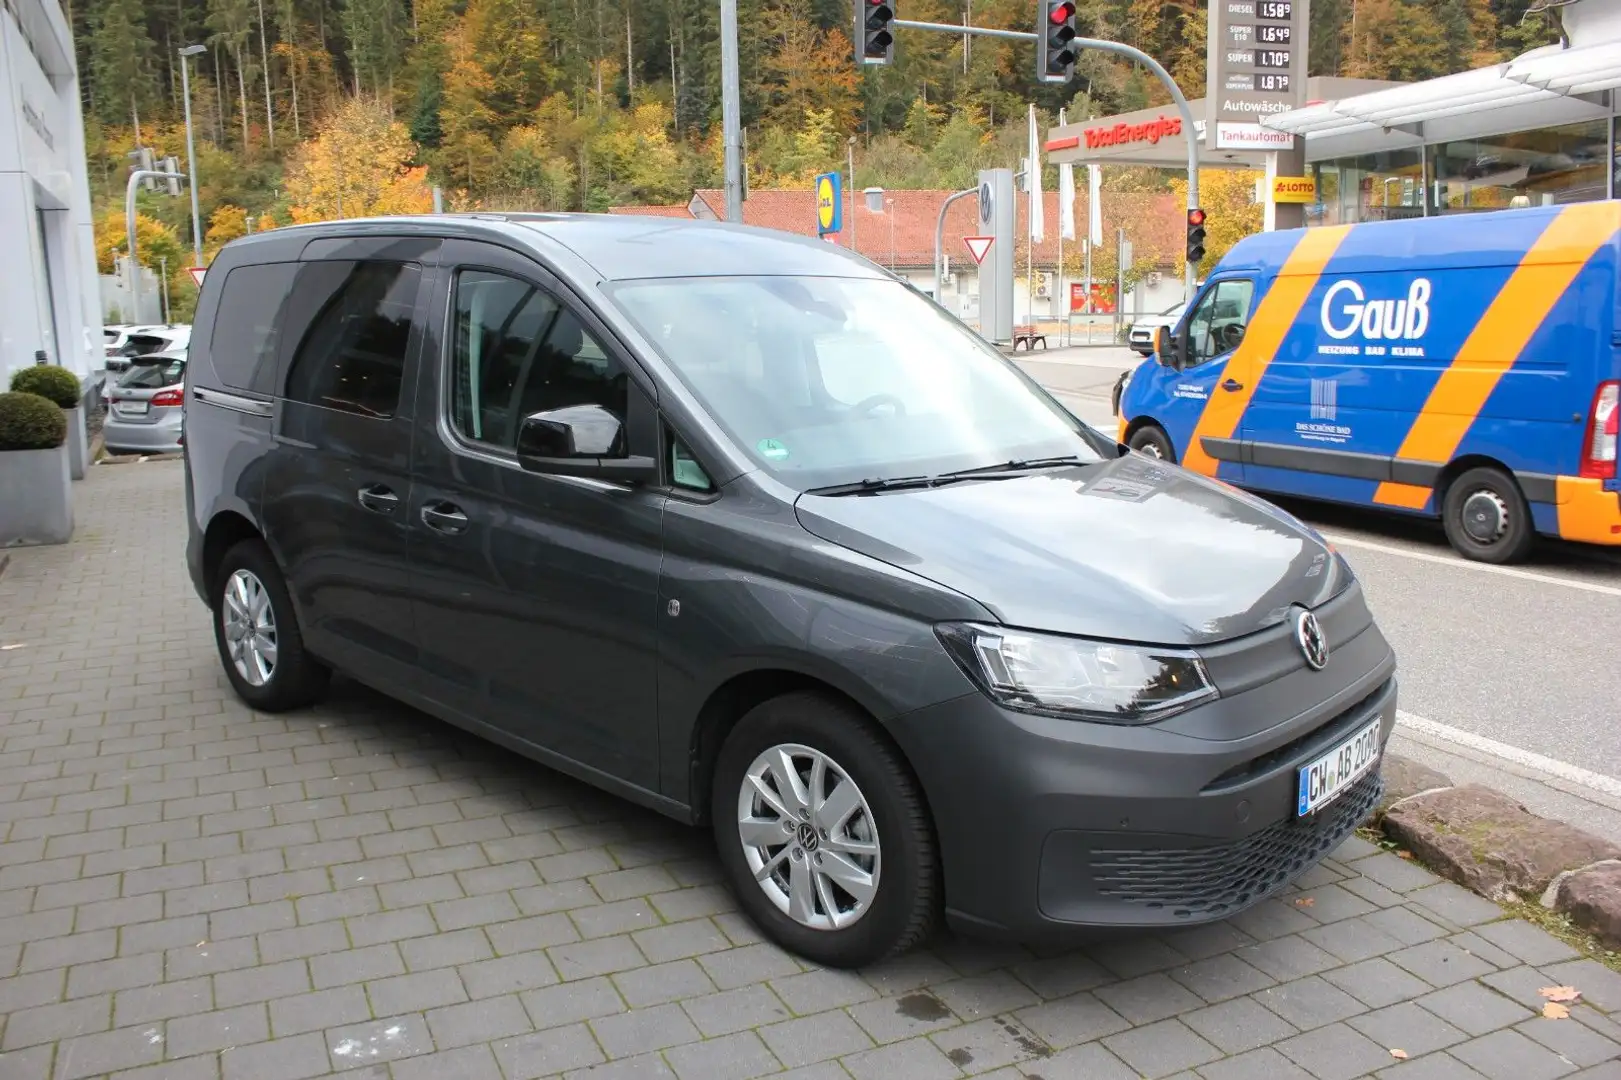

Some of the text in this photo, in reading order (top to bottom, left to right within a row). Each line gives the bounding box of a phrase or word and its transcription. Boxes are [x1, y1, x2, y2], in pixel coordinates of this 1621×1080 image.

[1228, 4, 1254, 14] DIESEL
[1229, 26, 1252, 34] SUPER
[1234, 33, 1247, 41] E10
[1227, 53, 1253, 63] SUPER
[1223, 99, 1293, 113] Autowäsche
[1083, 115, 1183, 149] TotalEnergies
[1221, 130, 1291, 143] Tankautomat
[1286, 183, 1314, 192] LOTTO
[1320, 277, 1432, 340] Gauß
[1317, 345, 1425, 357] HEIZUNG BAD KLIMA
[1309, 760, 1328, 802] CW
[1337, 745, 1352, 785] AB
